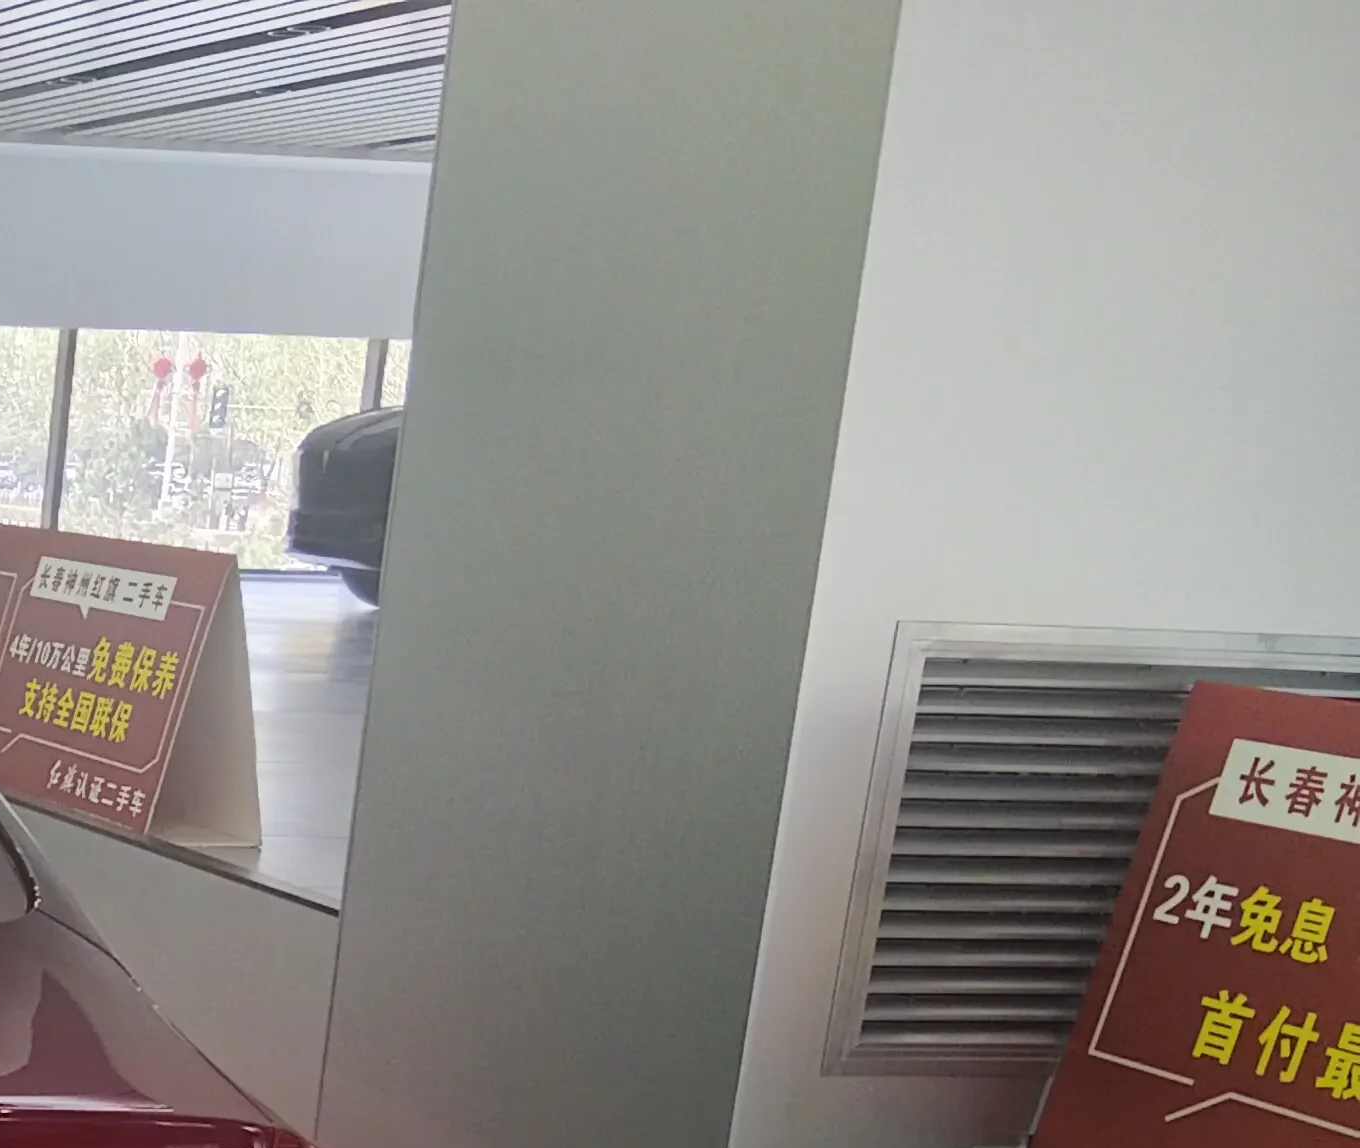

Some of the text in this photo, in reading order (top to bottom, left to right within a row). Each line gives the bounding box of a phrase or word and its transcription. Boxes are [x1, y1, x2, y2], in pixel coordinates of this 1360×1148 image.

[18, 678, 133, 743] 支持全国联保
[1153, 875, 1335, 963] 2年免息
